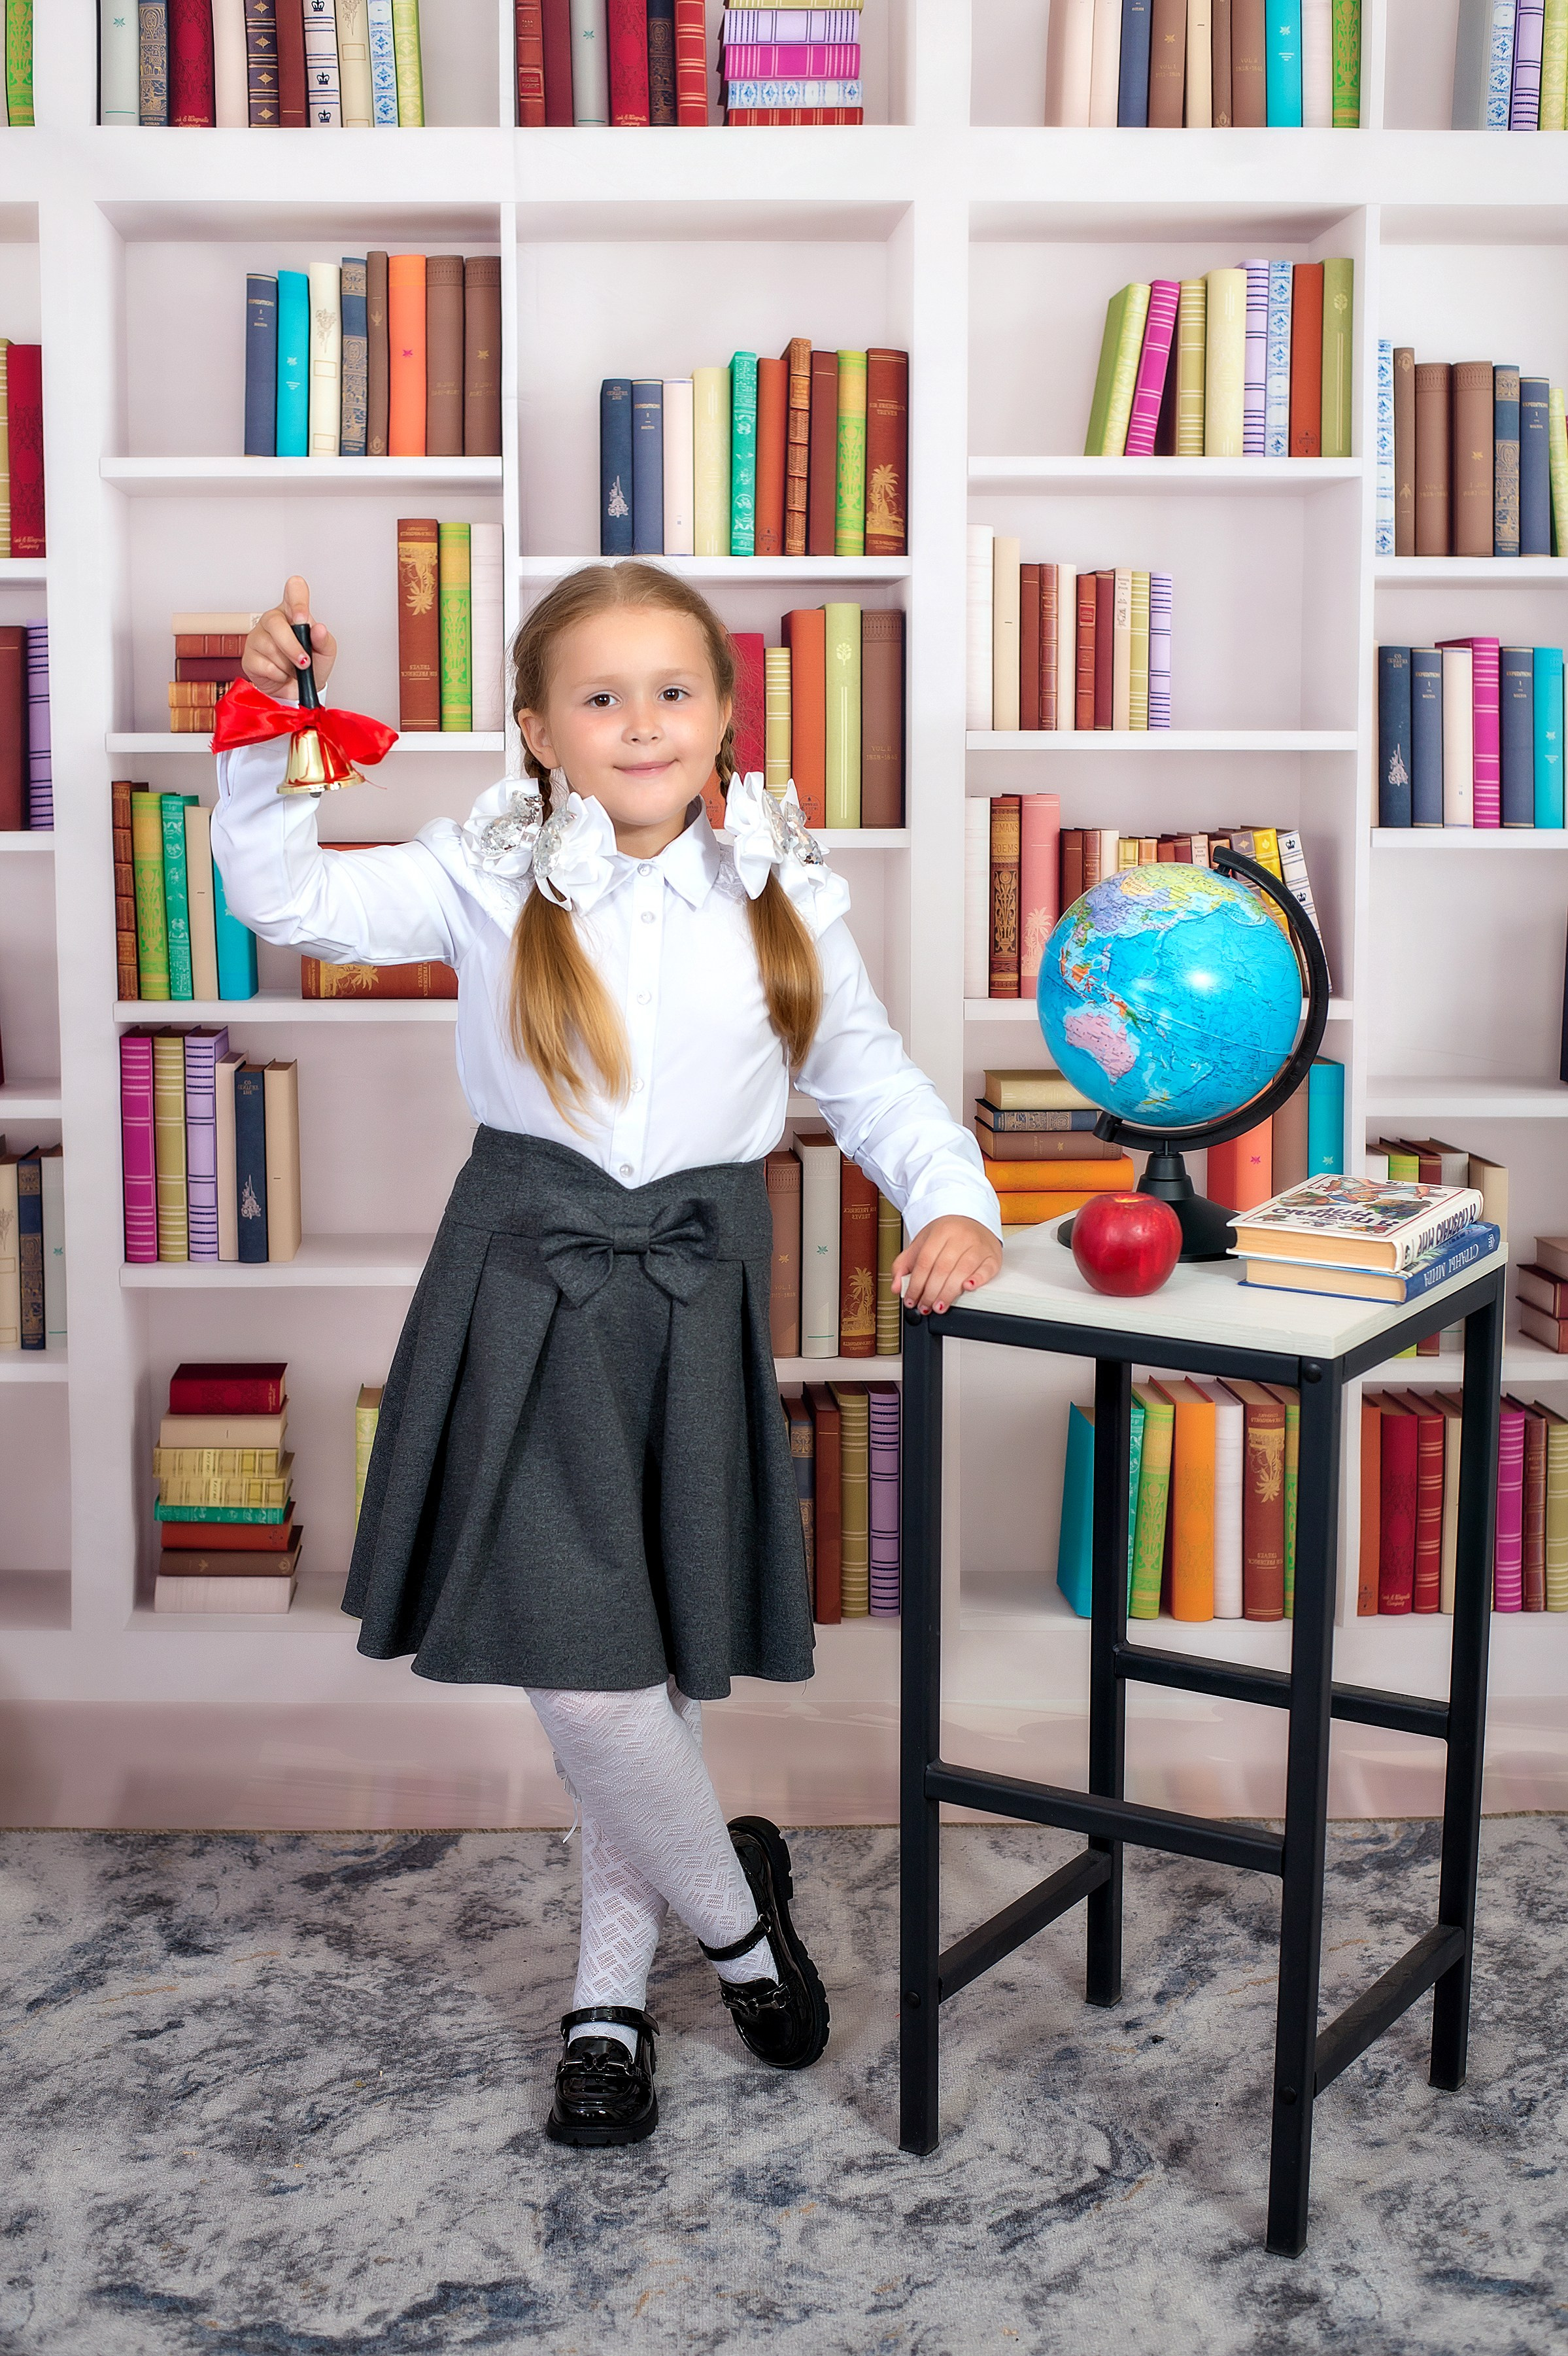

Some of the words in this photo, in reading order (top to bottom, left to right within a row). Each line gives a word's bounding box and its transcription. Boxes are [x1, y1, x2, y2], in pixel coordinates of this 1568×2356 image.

[991, 842, 1019, 854] POEMS
[1272, 1207, 1375, 1224] ПОЗНАЮ
[1316, 1207, 1374, 1217] МИР
[1436, 1206, 1469, 1245] ПОЗНАЮ
[1416, 1227, 1435, 1258] МИР
[1448, 1243, 1480, 1273] СТРАНЫ
[1423, 1262, 1446, 1287] МИРА
